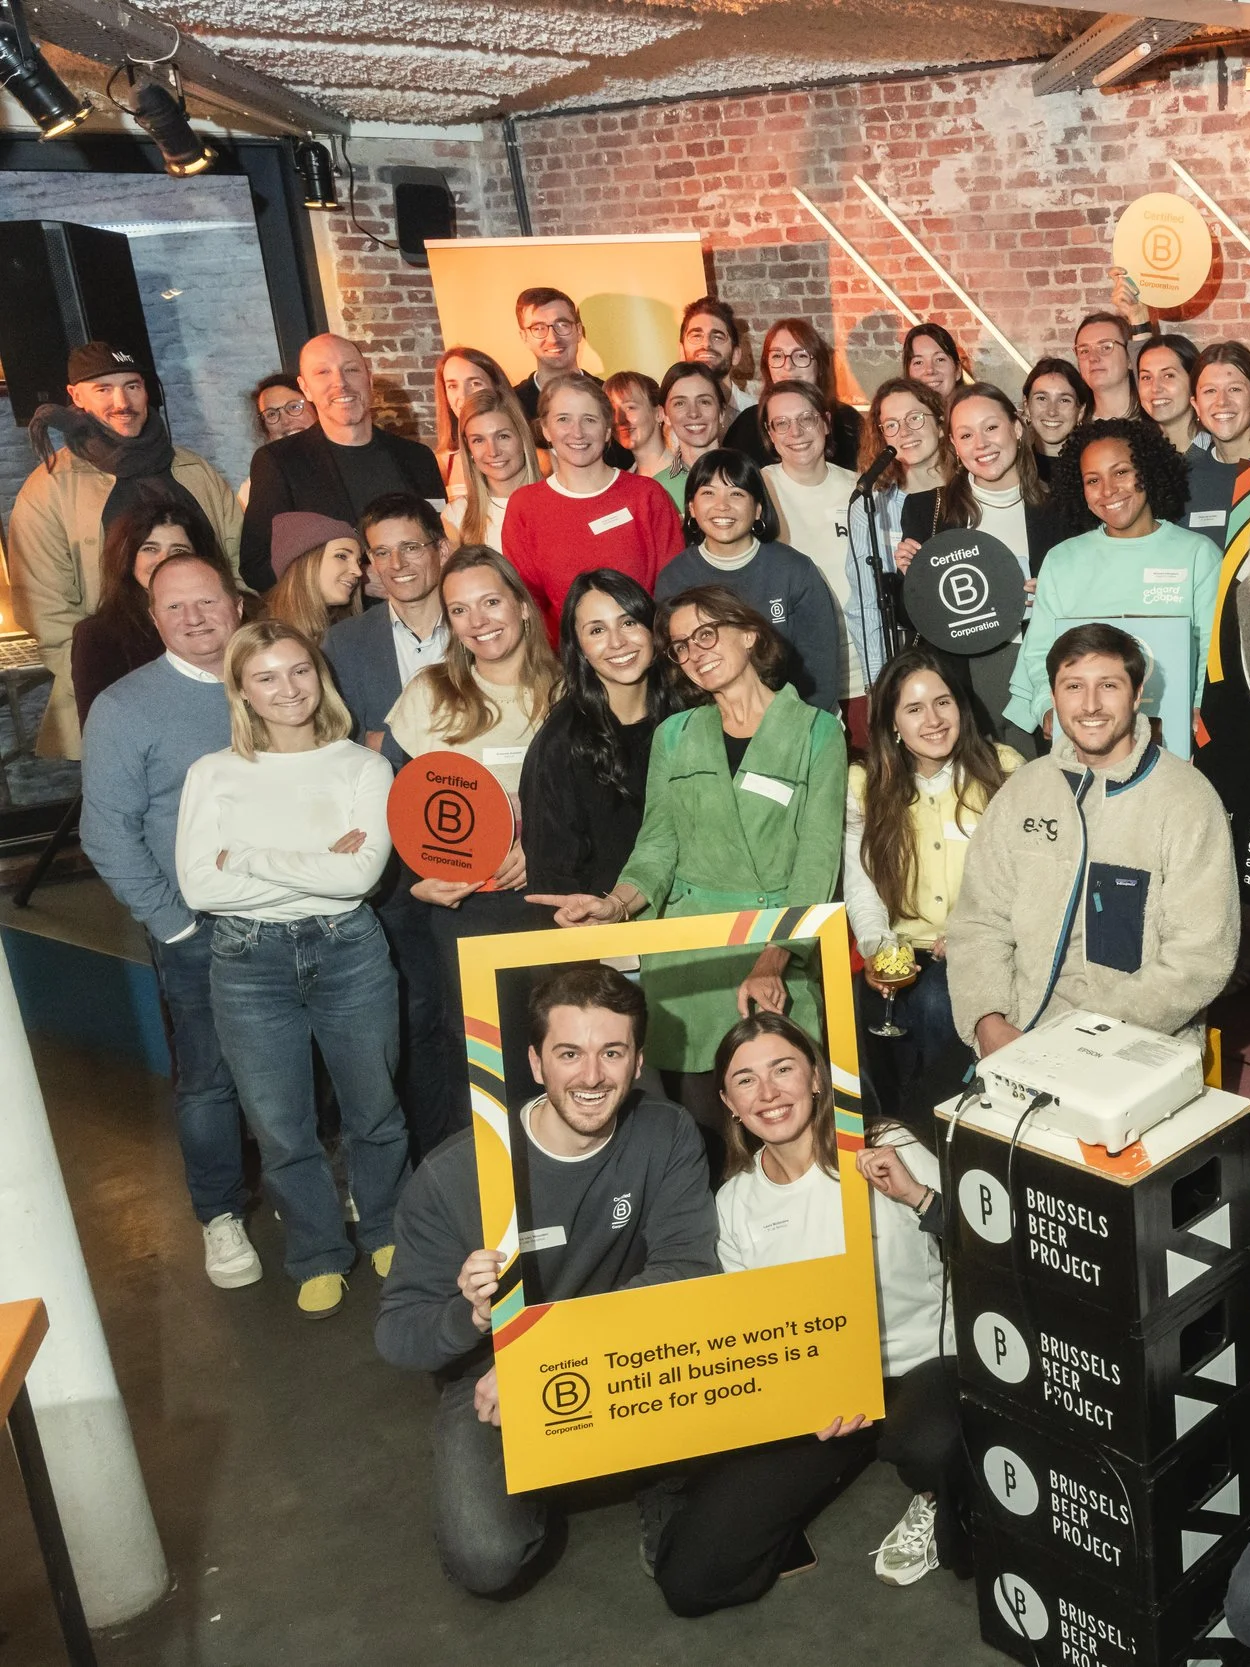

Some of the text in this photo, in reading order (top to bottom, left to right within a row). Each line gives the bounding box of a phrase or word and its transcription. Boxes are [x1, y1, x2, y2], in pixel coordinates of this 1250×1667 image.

[1144, 210, 1185, 223] Certified
[1140, 279, 1180, 290] Corporation
[930, 545, 980, 567] Certified
[1143, 586, 1181, 597] edgard
[950, 620, 1000, 638] Corporation
[426, 770, 478, 791] Certified
[421, 852, 472, 869] Corporation
[1026, 1187, 1109, 1238] BRUSSELS
[1028, 1213, 1068, 1248] BEER
[1030, 1238, 1102, 1287] PROJECT
[604, 1315, 847, 1369] Together, we won’t stop
[1040, 1332, 1121, 1385] BRUSSELS
[539, 1357, 589, 1373] Certified
[607, 1344, 819, 1395] until all business is a
[1042, 1357, 1081, 1392] BEER
[609, 1377, 762, 1420] force for good.
[545, 1422, 594, 1436] Corporation
[1050, 1469, 1129, 1525] BRUSSELS
[1051, 1492, 1089, 1529] BEER
[1052, 1516, 1121, 1567] PROJECT
[1061, 1620, 1098, 1657] BEER
